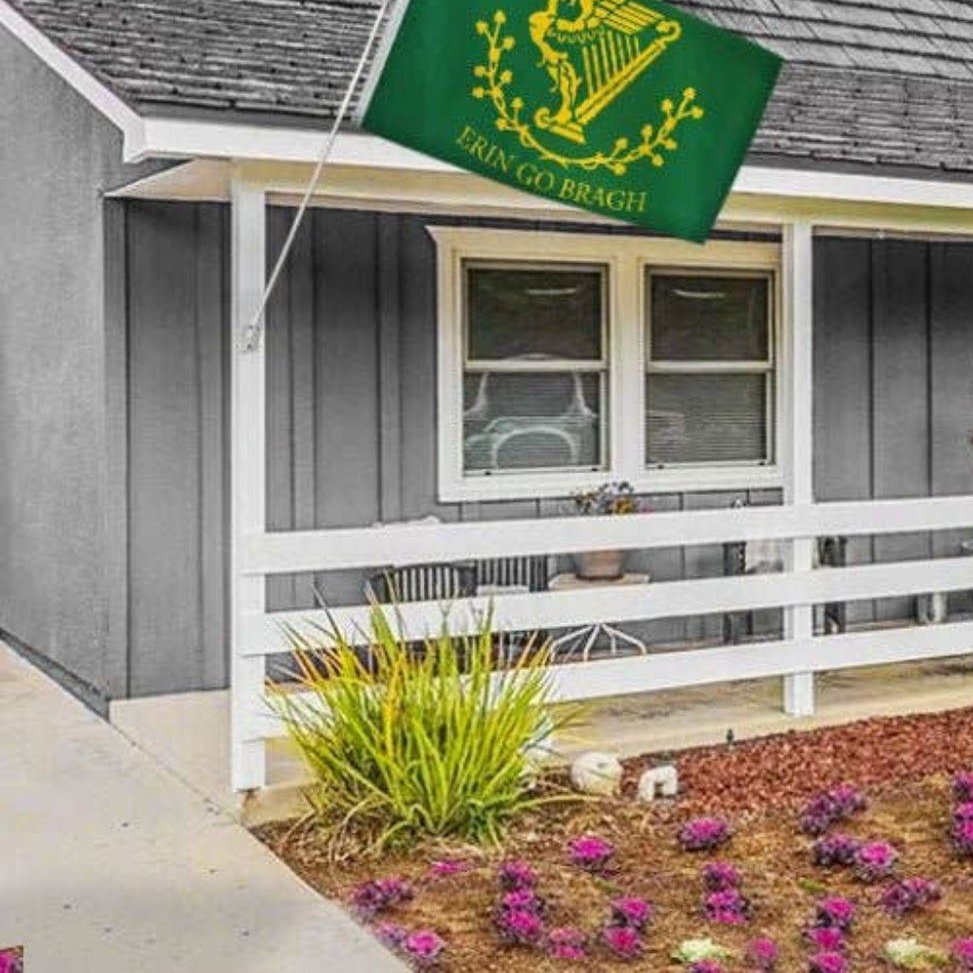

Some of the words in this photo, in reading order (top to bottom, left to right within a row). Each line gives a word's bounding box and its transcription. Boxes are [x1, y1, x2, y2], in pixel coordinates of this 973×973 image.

[456, 126, 515, 173] ERIN
[516, 162, 555, 191] GO
[559, 178, 648, 212] BRAGH
